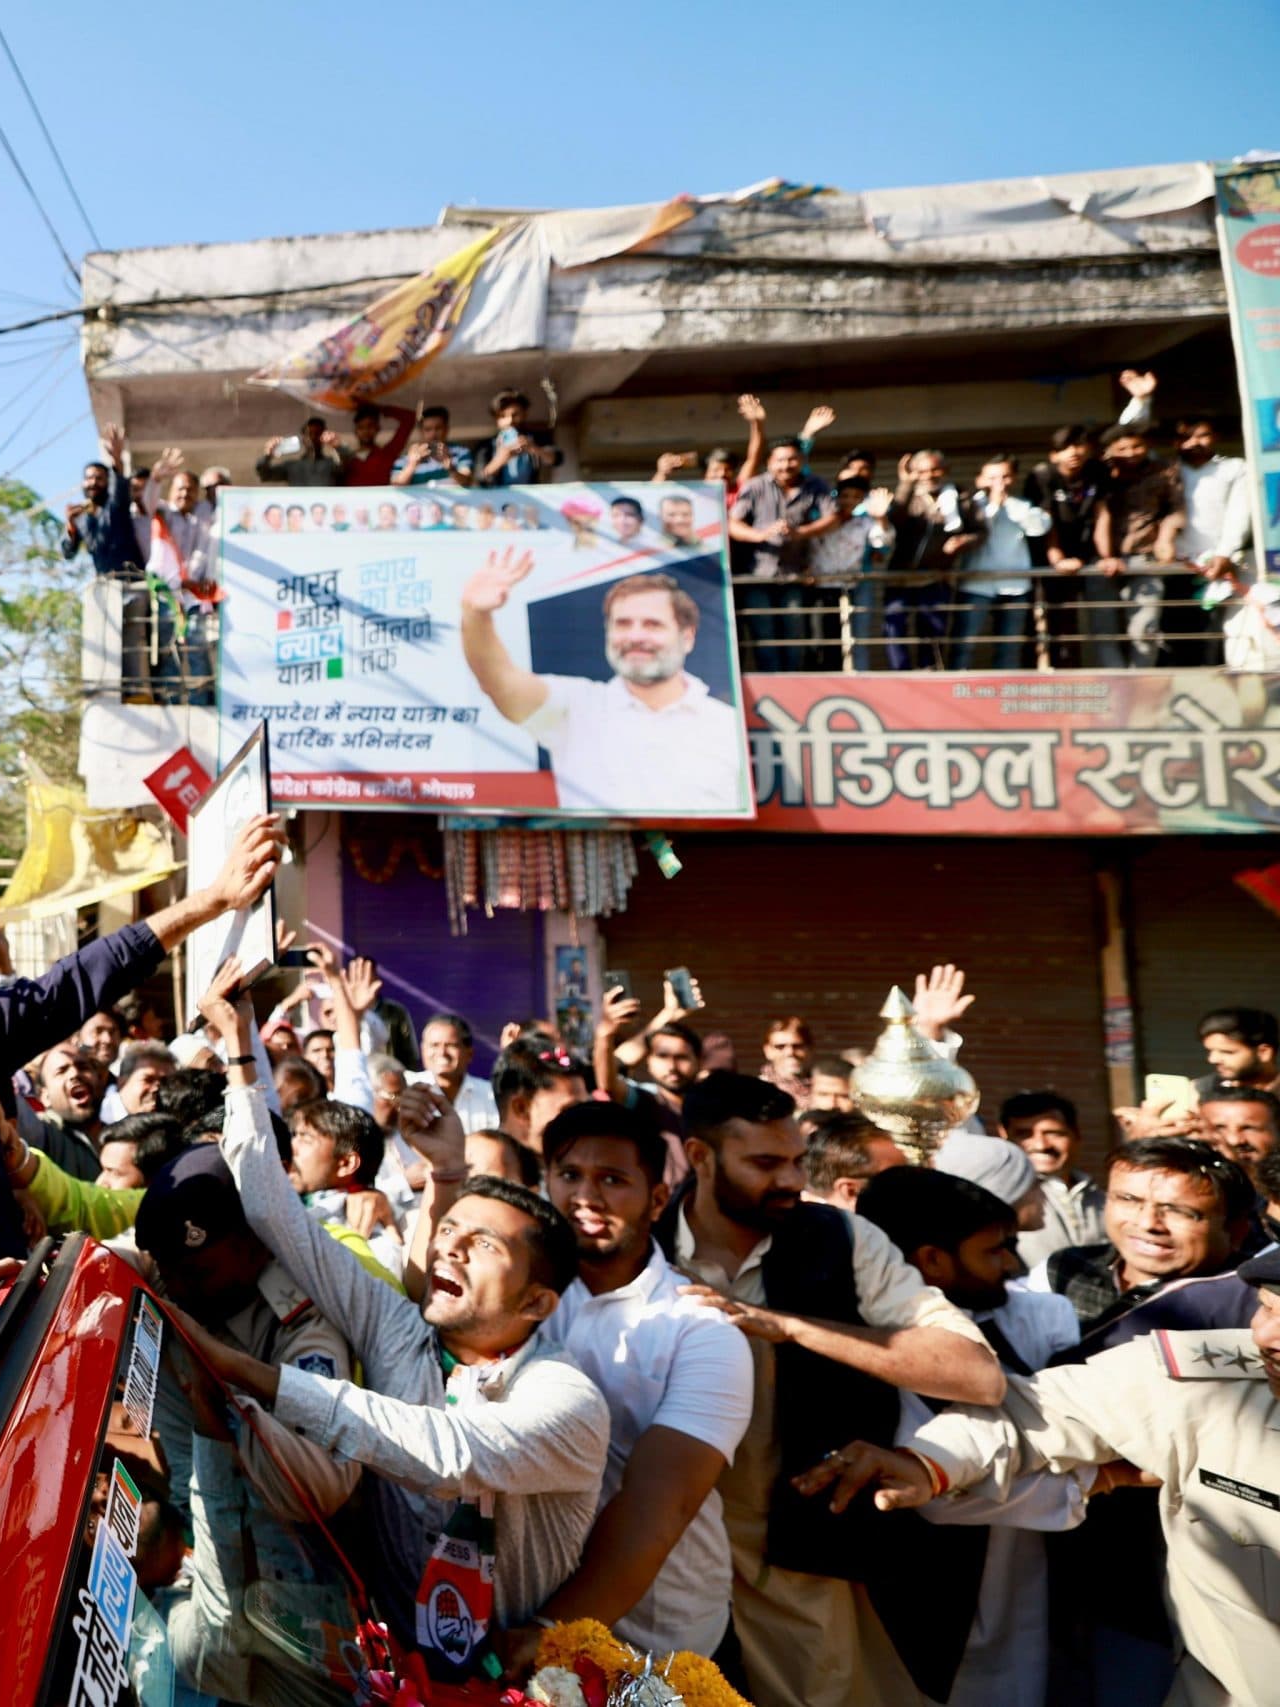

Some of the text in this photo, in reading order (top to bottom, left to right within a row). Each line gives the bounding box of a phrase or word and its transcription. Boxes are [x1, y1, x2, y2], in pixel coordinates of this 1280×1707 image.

[277, 569, 342, 604] भारत
[360, 608, 432, 648] मिलने
[278, 631, 340, 660] न्याय
[277, 661, 322, 685] यात्रा
[358, 647, 399, 674] तक
[231, 699, 480, 725] मध्यप्रदेश में न्याय यात्रा का
[277, 727, 433, 750] हार्दिक अभिनंदन
[109, 1479, 138, 1553] यात्रा
[94, 1534, 132, 1627] न्याय
